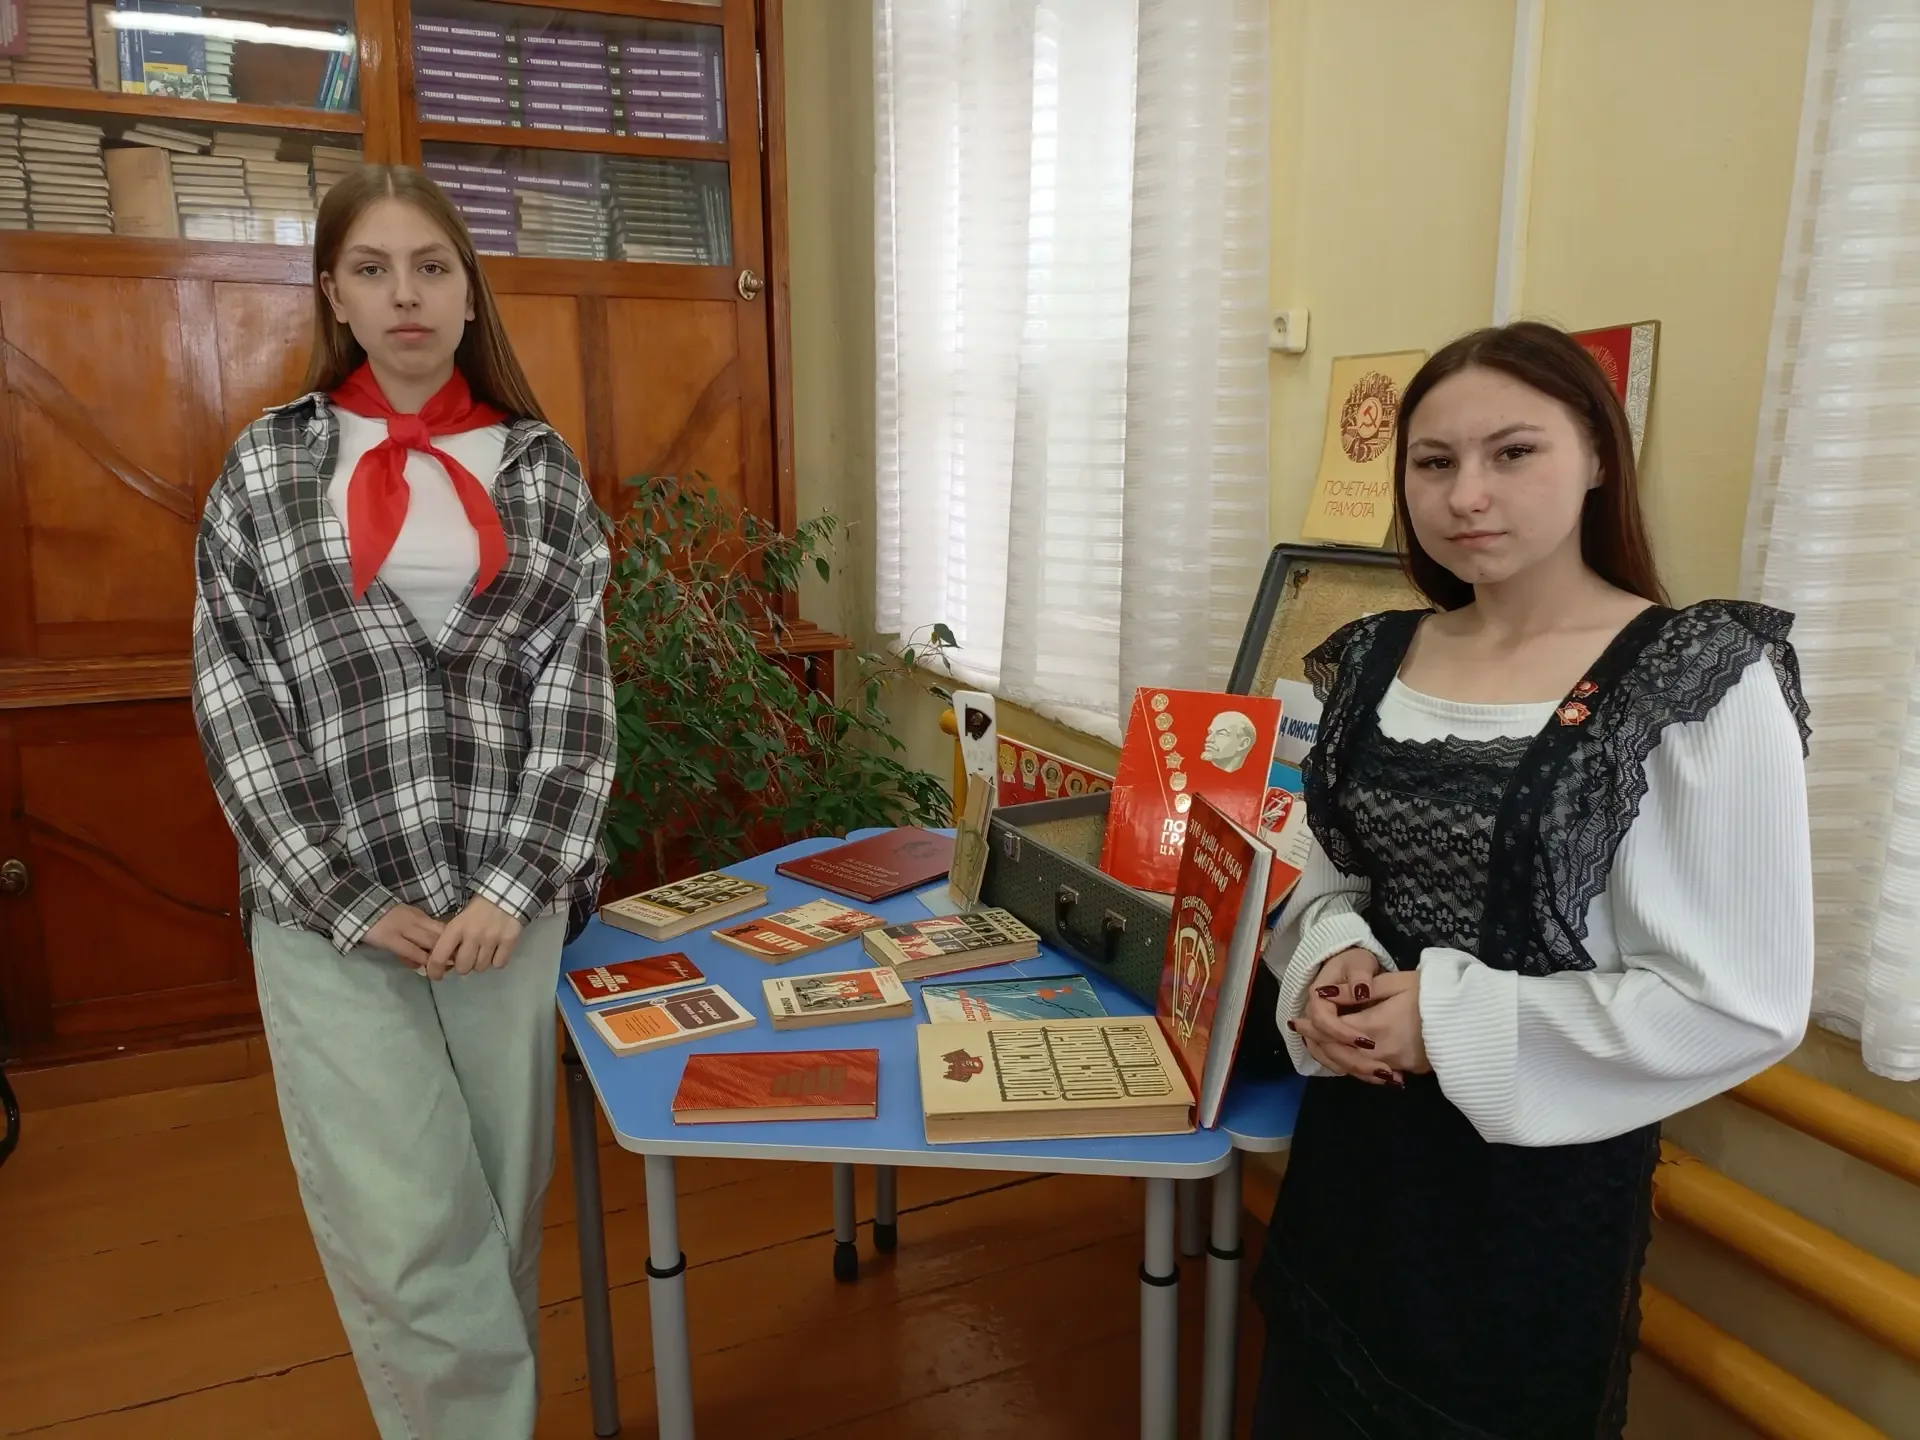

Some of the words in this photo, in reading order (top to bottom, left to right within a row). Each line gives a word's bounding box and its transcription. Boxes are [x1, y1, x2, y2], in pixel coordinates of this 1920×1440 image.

[1323, 480, 1389, 497] ПОЧЕТНАЯ
[1323, 501, 1375, 518] ГРАМОТА
[1159, 845, 1176, 856] ЦК
[1189, 818, 1201, 838] ЭТО
[1201, 829, 1219, 859] НАША
[1218, 849, 1224, 861] С
[1223, 850, 1243, 884] ТОБОЙ
[1193, 847, 1229, 893] БИОГРАФИЯ
[1181, 895, 1214, 925] ЛЕНИНСКОМУ
